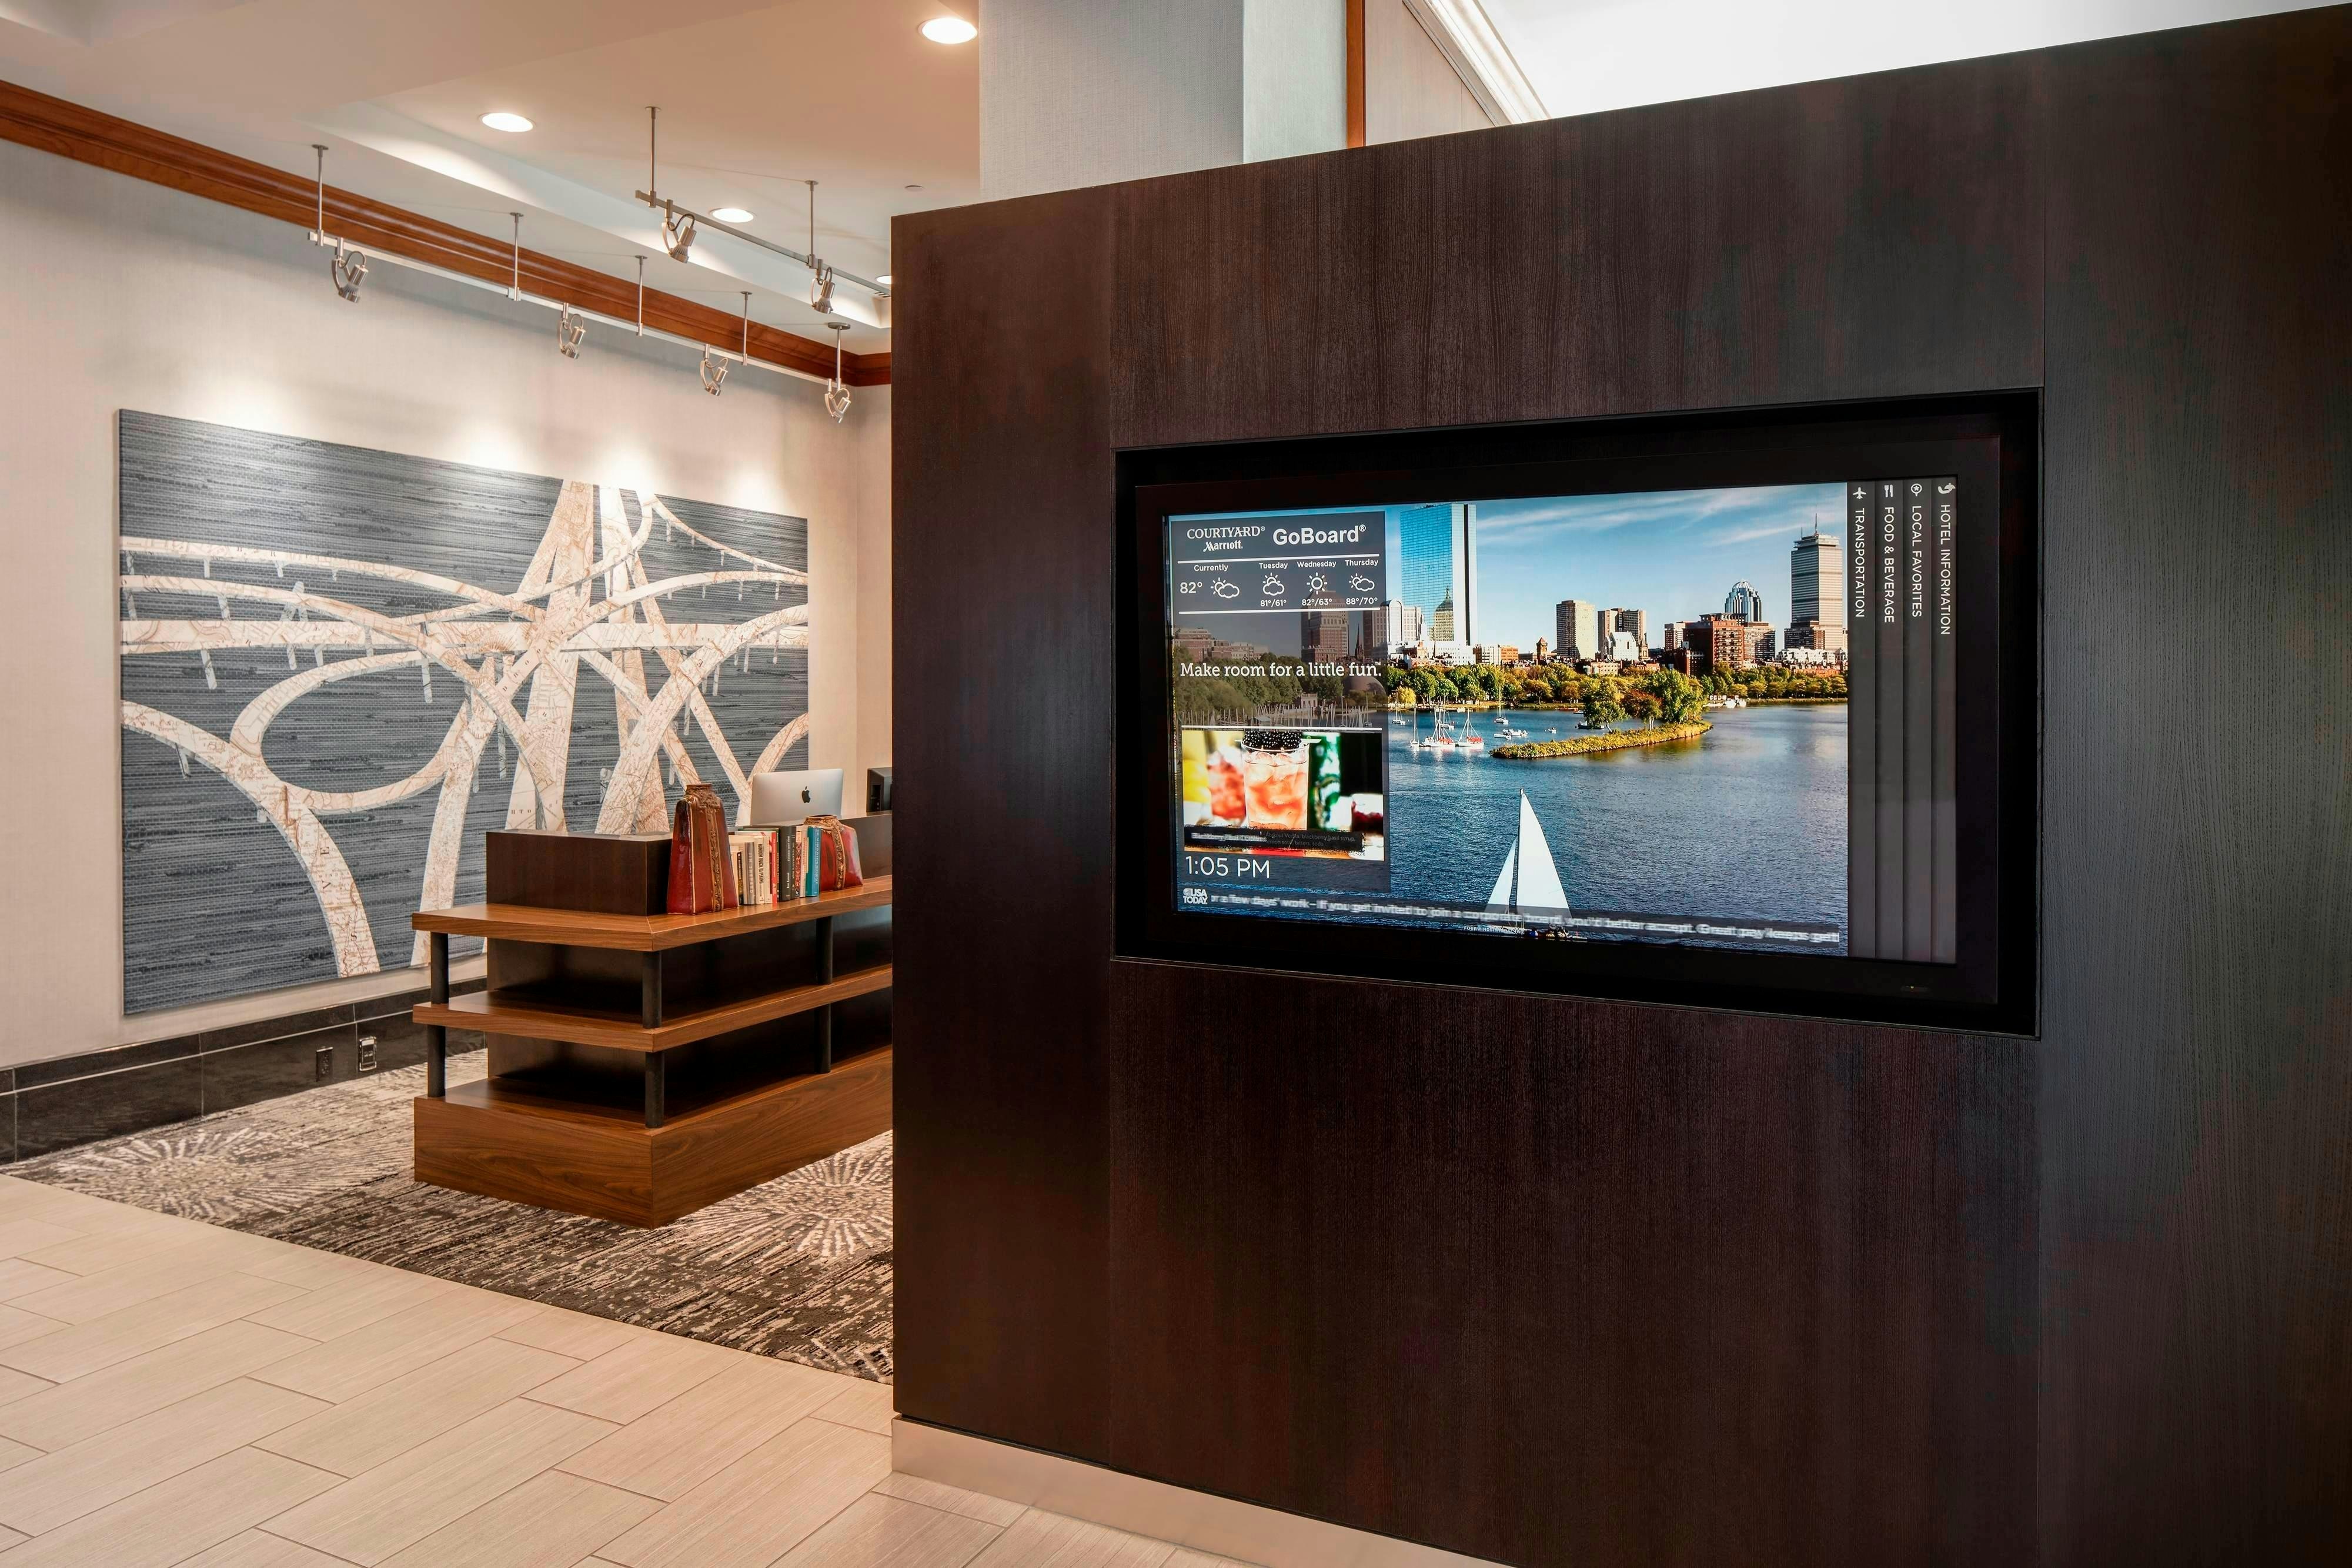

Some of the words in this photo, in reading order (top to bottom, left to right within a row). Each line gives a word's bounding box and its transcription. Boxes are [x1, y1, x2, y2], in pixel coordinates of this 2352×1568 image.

[1884, 507, 1895, 542] FOOD
[1912, 506, 1922, 547] LOCAL
[1940, 504, 1950, 545] HOTEL
[1884, 546, 1895, 554] &
[1194, 563, 1229, 572] Currently
[1259, 561, 1288, 570] Tuesday
[1297, 560, 1337, 569] Wednesday
[1345, 559, 1379, 567] Thursday
[1855, 507, 1865, 617] TRANSPORTATION
[1180, 581, 1203, 594] 82°
[1884, 558, 1895, 623] BEVERAGE
[1912, 550, 1922, 617] FAVORITES
[1940, 549, 1950, 634] INFORMATION
[1180, 663, 1221, 677] Make
[1224, 666, 1265, 677] room
[1269, 662, 1292, 677] for
[1296, 666, 1305, 677] a
[1308, 662, 1345, 677] little
[1184, 855, 1229, 876] 1:05
[1237, 858, 1270, 878] PM
[1190, 888, 1207, 897] USA
